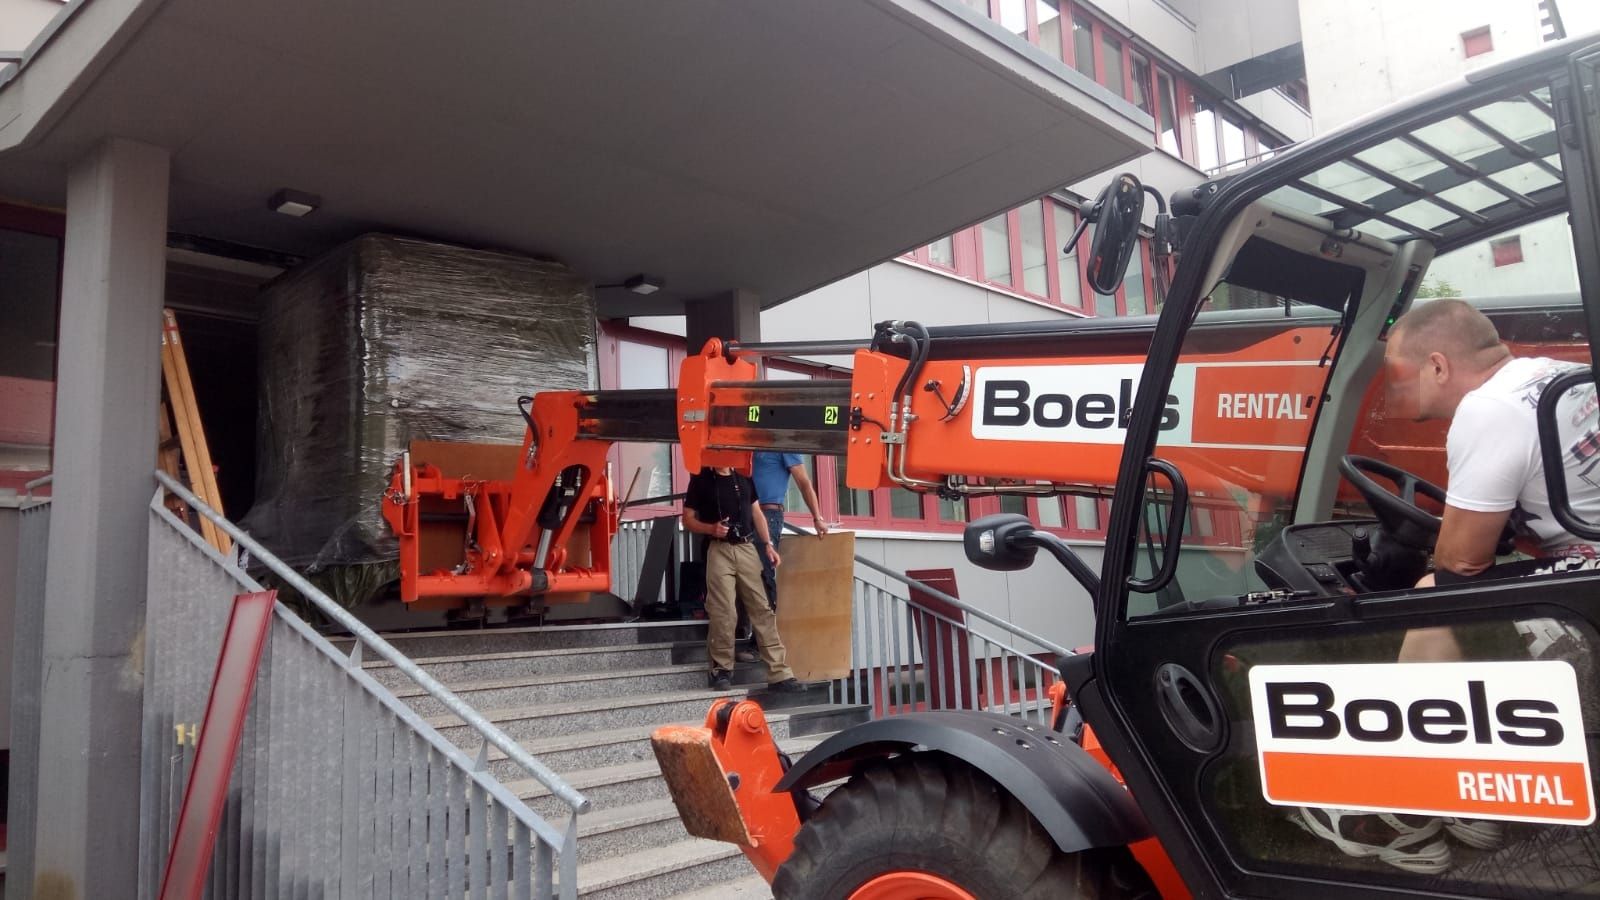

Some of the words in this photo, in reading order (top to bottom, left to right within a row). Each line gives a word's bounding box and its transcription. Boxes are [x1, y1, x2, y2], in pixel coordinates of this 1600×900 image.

[1217, 393, 1308, 420] RENTAL
[1265, 680, 1564, 747] Boels
[1457, 771, 1574, 806] RENTAL
